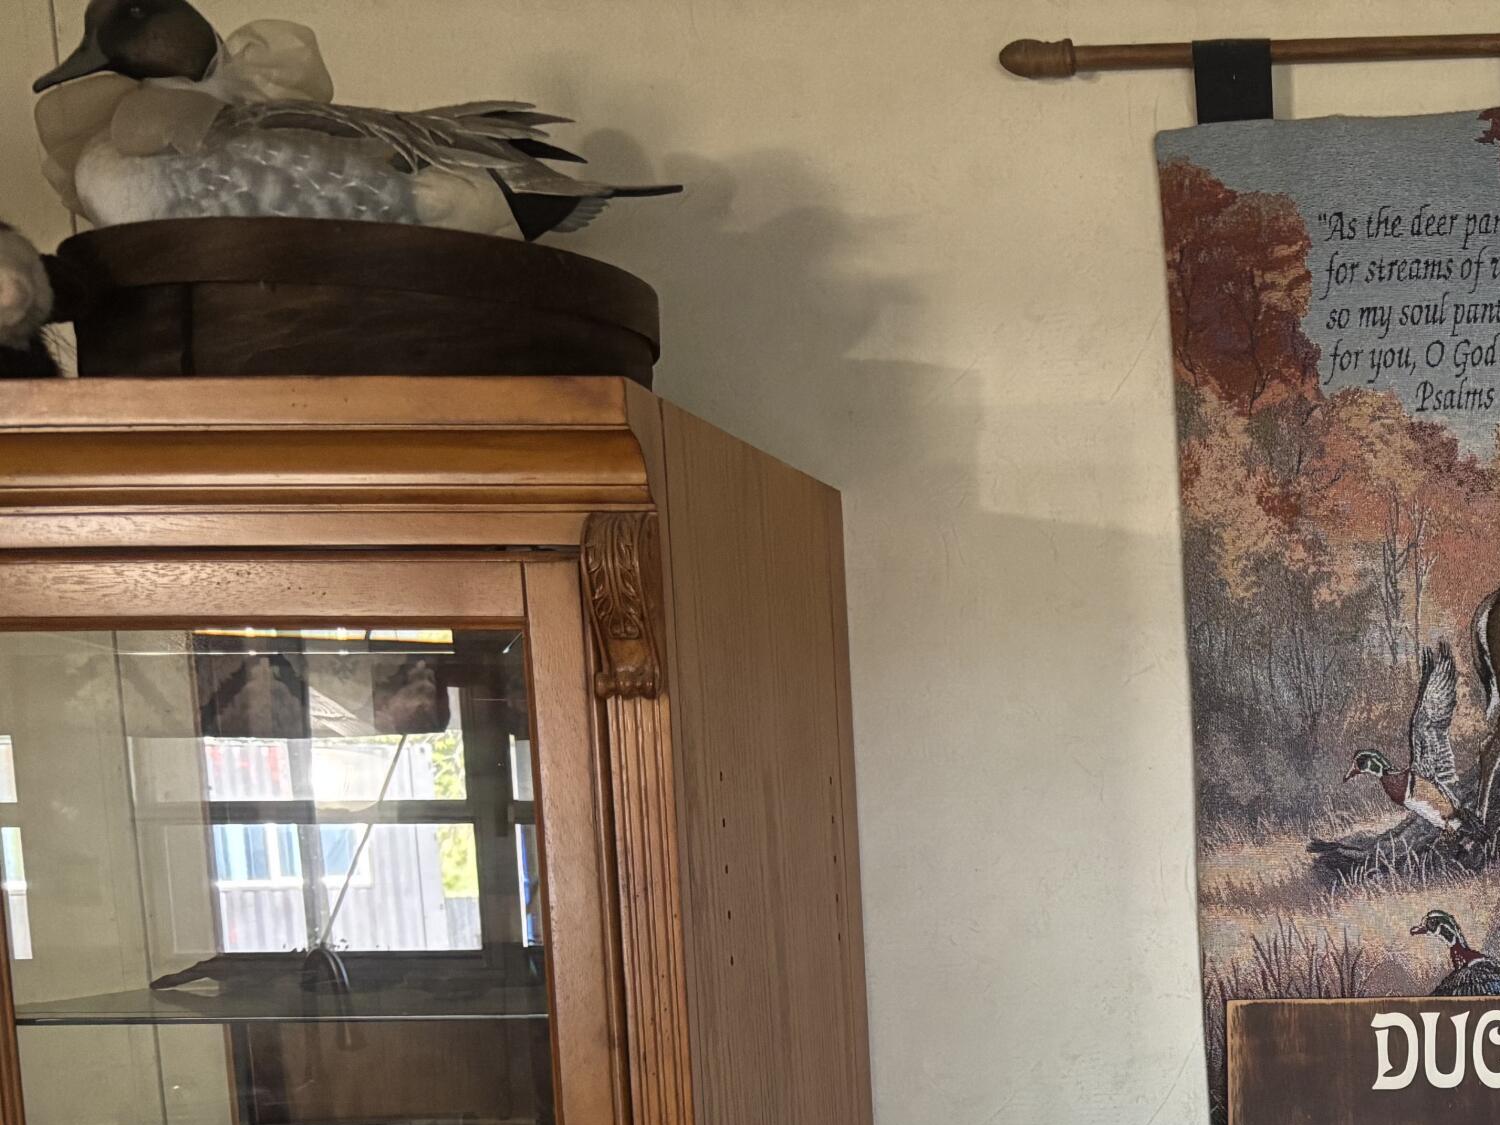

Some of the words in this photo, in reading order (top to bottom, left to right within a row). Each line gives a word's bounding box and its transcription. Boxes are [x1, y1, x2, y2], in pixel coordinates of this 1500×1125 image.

[1318, 211, 1356, 241] "As
[1366, 206, 1402, 239] the
[1410, 204, 1458, 237] deer
[1319, 251, 1359, 300] for
[1365, 256, 1453, 283] streams
[1460, 246, 1488, 293] of
[1326, 306, 1350, 329] so
[1359, 304, 1391, 339] my
[1399, 292, 1449, 326] soul
[1324, 338, 1362, 385] for
[1368, 347, 1416, 383] you,
[1425, 340, 1445, 368] O
[1415, 378, 1494, 412] Psalms
